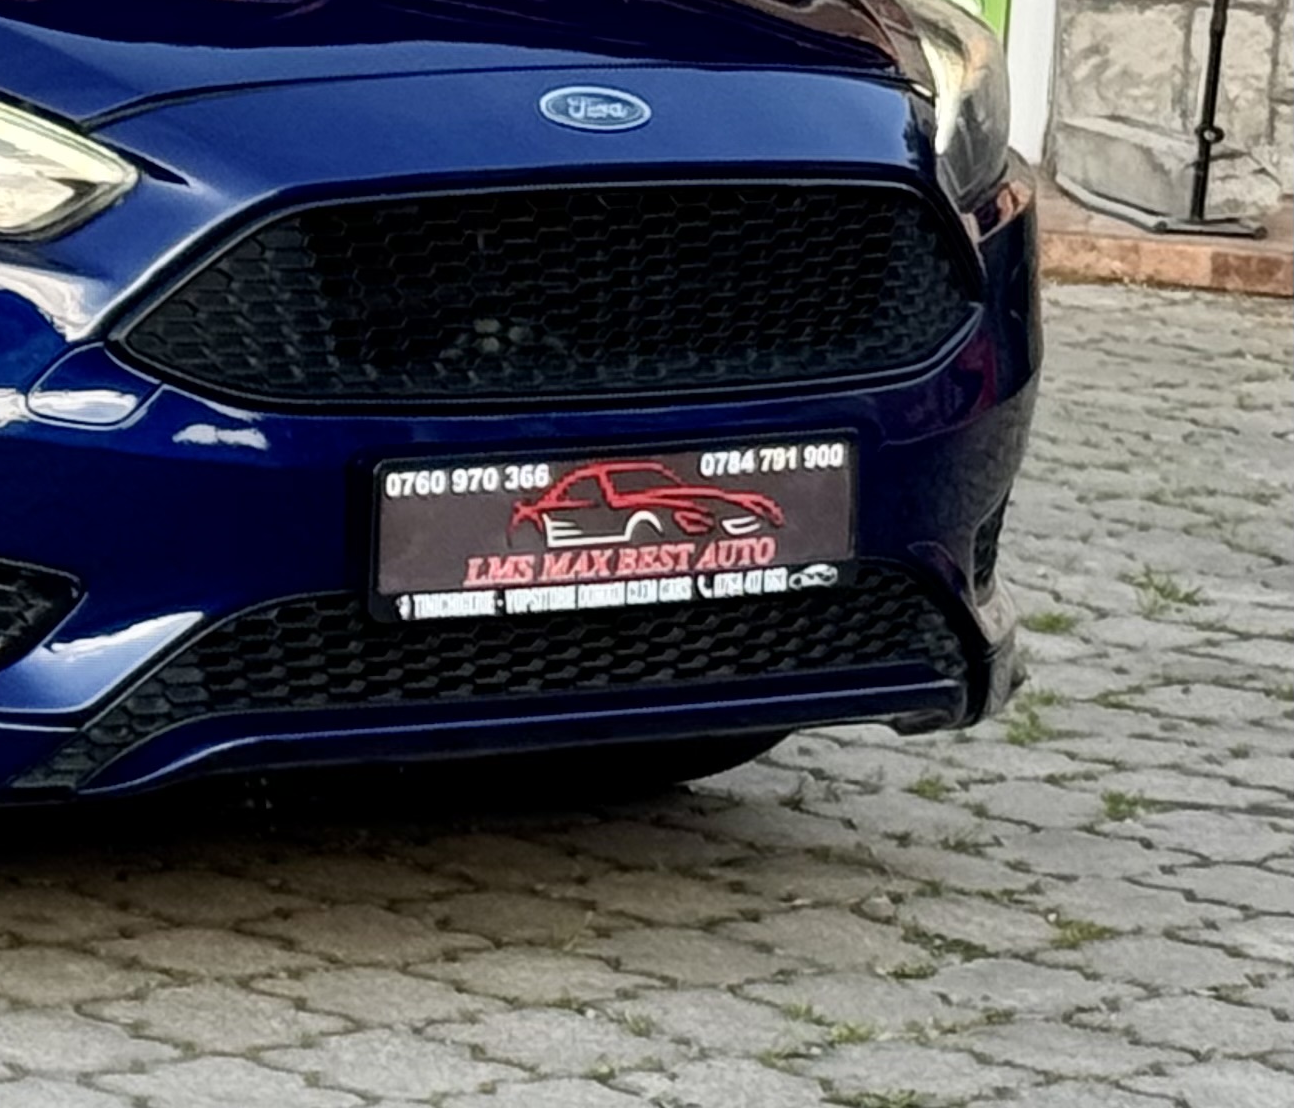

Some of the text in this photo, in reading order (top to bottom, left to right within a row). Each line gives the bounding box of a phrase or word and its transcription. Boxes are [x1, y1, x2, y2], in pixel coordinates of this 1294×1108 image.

[700, 443, 845, 476] 0784 791 900
[386, 471, 446, 498] 0760
[452, 466, 499, 493] 970
[463, 537, 777, 588] LMS MAX BEST AUTO
